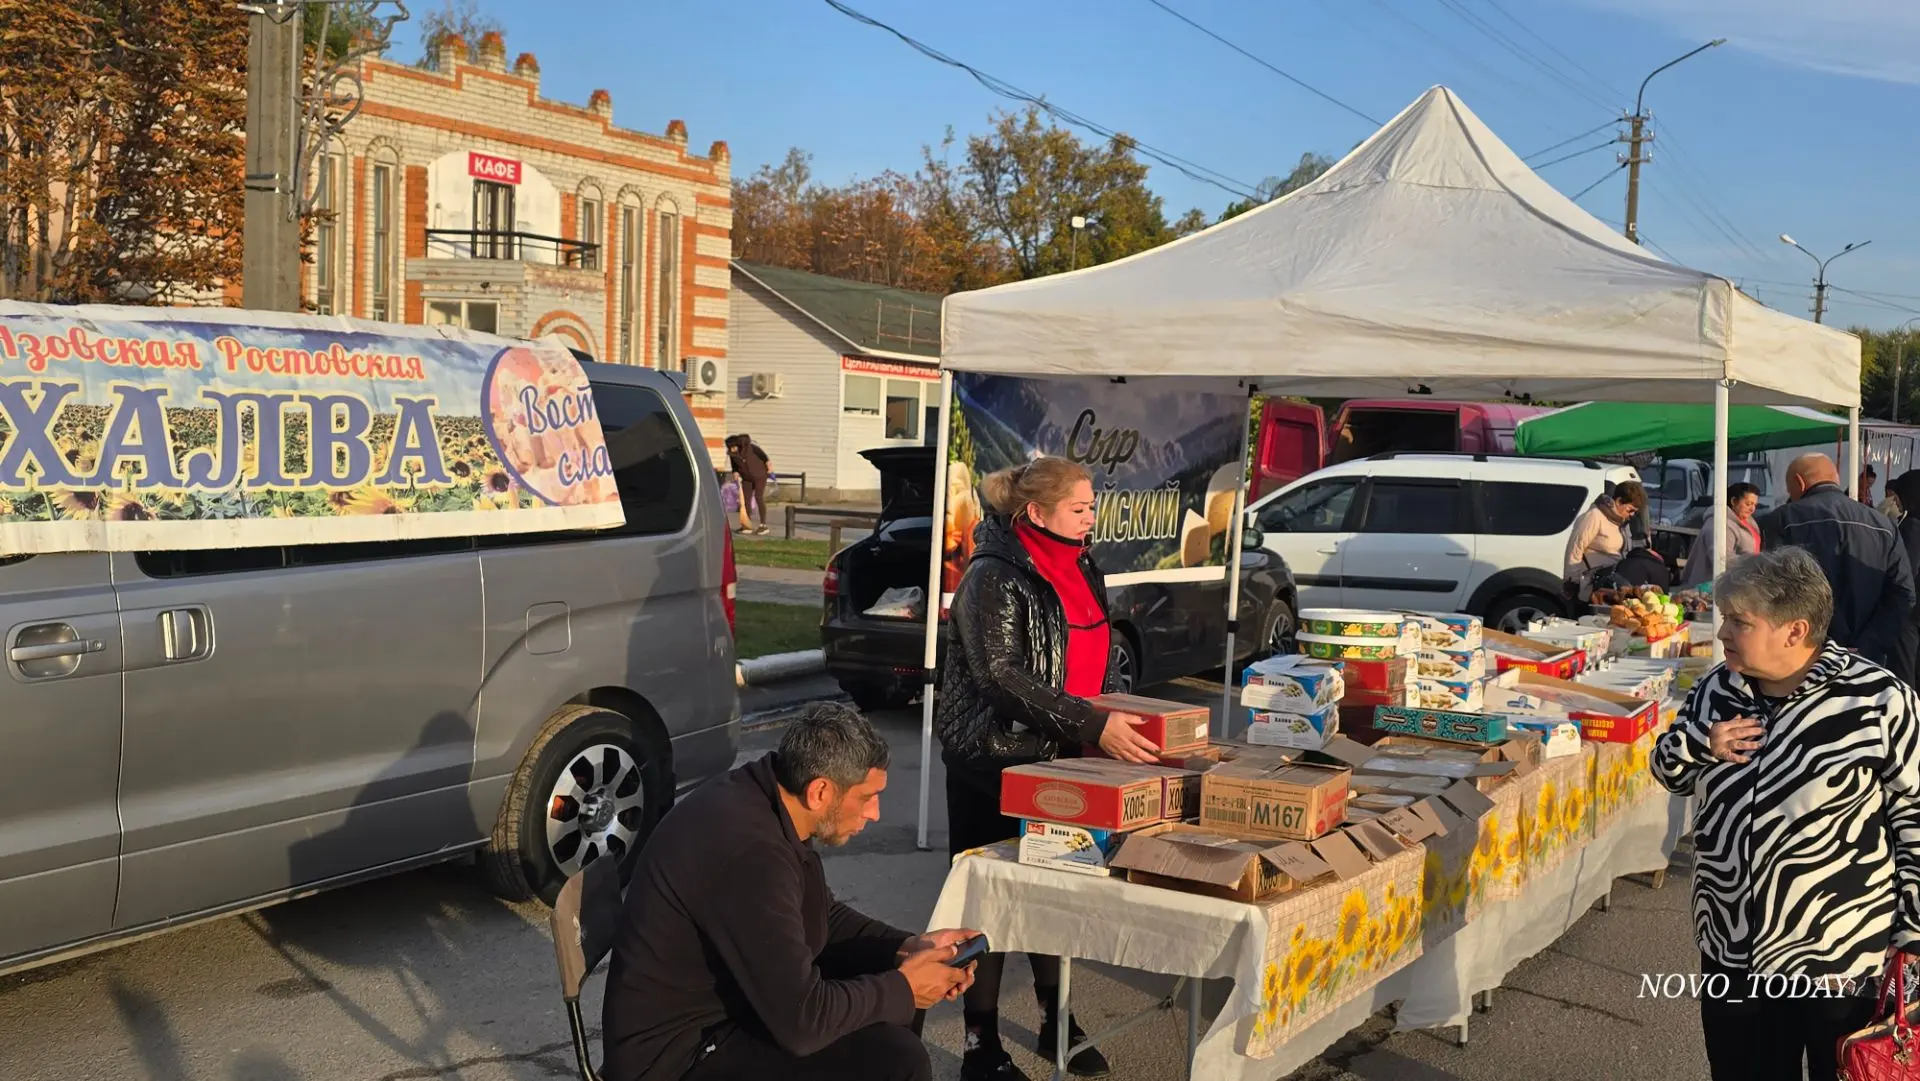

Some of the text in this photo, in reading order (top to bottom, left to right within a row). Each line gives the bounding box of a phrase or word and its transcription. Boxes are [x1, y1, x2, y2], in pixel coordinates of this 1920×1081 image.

[474, 157, 516, 179] КАФЕ
[216, 336, 425, 380] Ростовская
[0, 380, 453, 489] ХАЛВА
[1065, 407, 1140, 476] Сыр
[1253, 801, 1305, 829] M167
